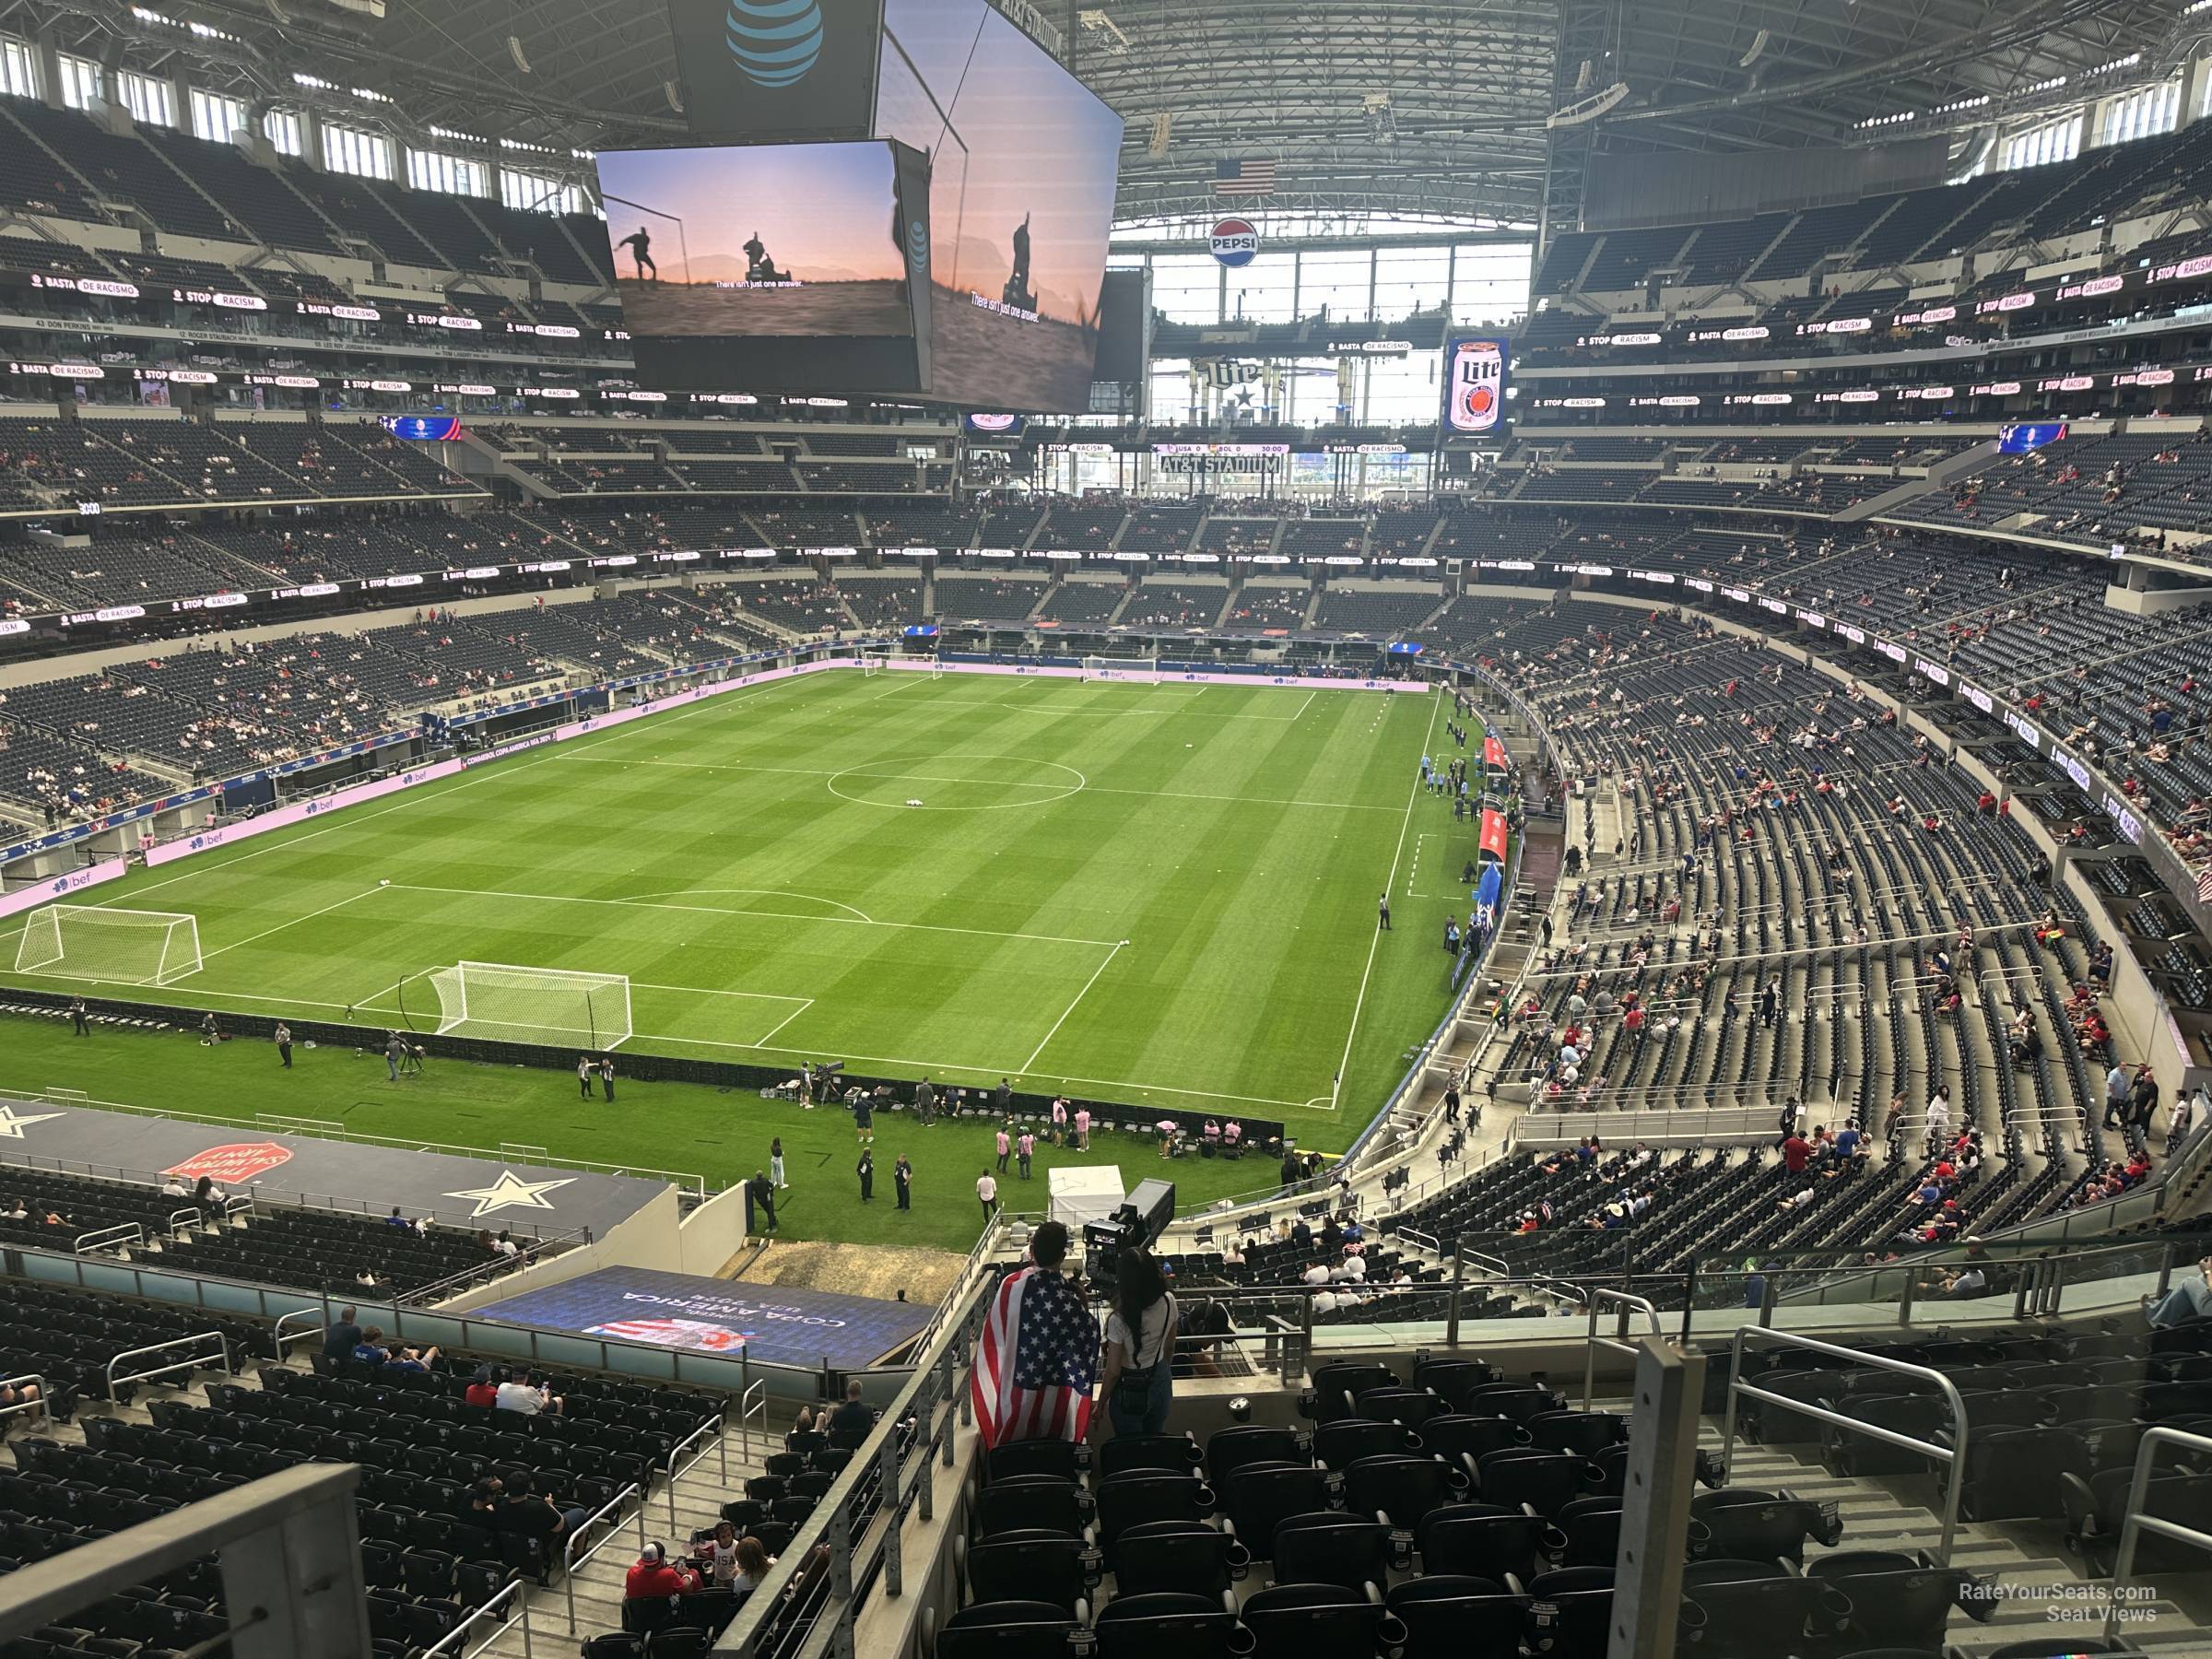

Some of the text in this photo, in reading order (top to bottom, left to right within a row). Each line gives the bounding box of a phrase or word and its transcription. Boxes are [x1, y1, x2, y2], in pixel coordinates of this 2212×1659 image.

[1212, 238, 1255, 249] PEPSI
[2156, 257, 2212, 281] STOP RACISM
[46, 276, 135, 295] BASTA DE RACISMO
[750, 280, 762, 288] just
[2064, 278, 2120, 298] BASTA DE RACISMO
[187, 290, 255, 308] STOP RACISM
[971, 290, 988, 309] There
[999, 302, 1010, 315] just
[1011, 306, 1020, 318] one
[1983, 296, 2027, 312] STOP RACISM
[308, 304, 331, 314] BASTA
[347, 308, 377, 318] RACISMO
[1901, 310, 1953, 323] BASTA DE RACISMO
[418, 314, 472, 326] STOP RACISM
[515, 324, 535, 333] BASTA
[548, 327, 576, 335] RACISMO
[1736, 328, 1766, 336] RACISMO
[1807, 321, 1862, 333] STOP RACISM
[1589, 336, 1610, 345] STOP
[22, 363, 100, 377] BASTA DE RACISMO
[145, 370, 207, 382] STOP RACISM
[1207, 360, 1258, 390] Lite
[1462, 361, 1500, 384] Lite
[253, 374, 316, 386] BASTA DE RACISMO
[352, 380, 371, 388] STOP
[2045, 379, 2086, 390] STOP RACISM
[2120, 371, 2174, 385] BASTA DE RACISMO
[1734, 395, 1751, 404] STOP
[1905, 389, 1947, 398] STOP RACISM
[1162, 456, 1277, 473] AT&T STADIUM
[78, 503, 100, 514] 30:00
[370, 576, 416, 589] STOP RACISM
[182, 596, 238, 609] STOP RACISM
[71, 613, 95, 622] BASTA
[112, 609, 141, 618] RACISMO
[321, 799, 334, 810] bef
[2107, 797, 2121, 818] STOP
[207, 832, 222, 845] bef
[72, 872, 91, 888] bef
[766, 1312, 846, 1327] COPA
